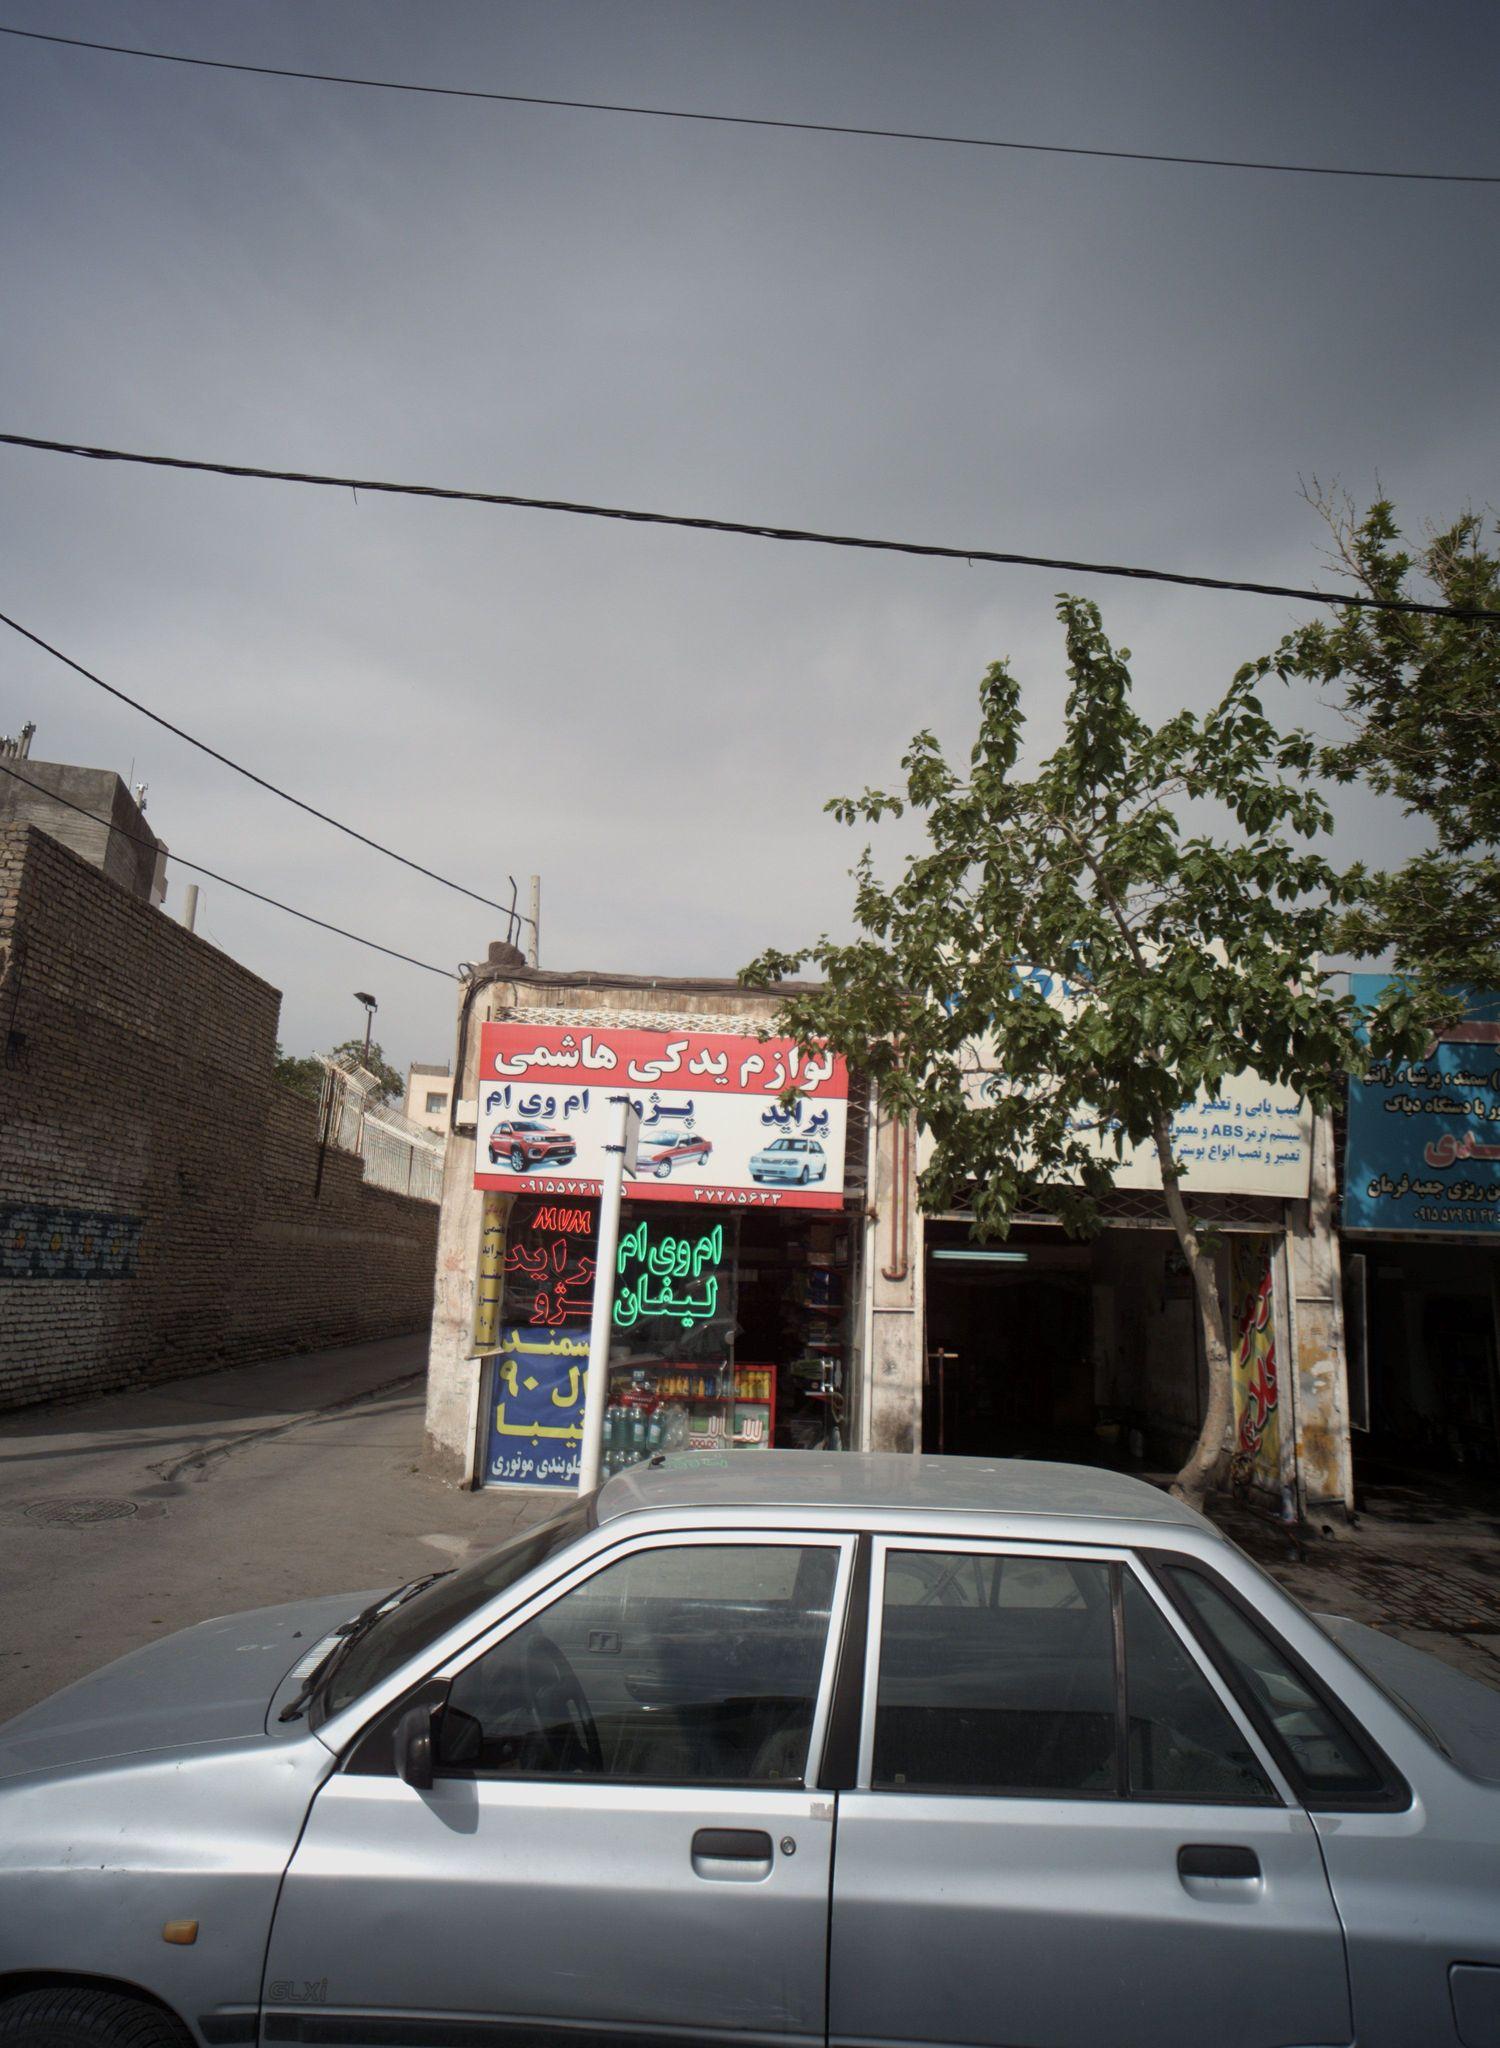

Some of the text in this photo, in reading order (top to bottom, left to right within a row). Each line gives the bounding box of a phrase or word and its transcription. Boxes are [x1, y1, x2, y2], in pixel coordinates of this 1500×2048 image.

[494, 1034, 834, 1091] لوازم یدکی هاشمی
[486, 1085, 512, 1116] ام
[518, 1094, 557, 1117] وی
[563, 1089, 590, 1119] ام
[761, 1100, 830, 1139] پراید
[1211, 1125, 1243, 1137] ABS
[520, 1179, 628, 1196] ۰۹۱۵۵۷۴۱۵
[504, 1239, 598, 1284] راید
[617, 1222, 723, 1277] ام وی ام
[529, 1281, 594, 1325] ژو
[613, 1274, 719, 1327] لیفان
[492, 1452, 533, 1477] موتوری
[269, 1977, 328, 2001] GLXi
